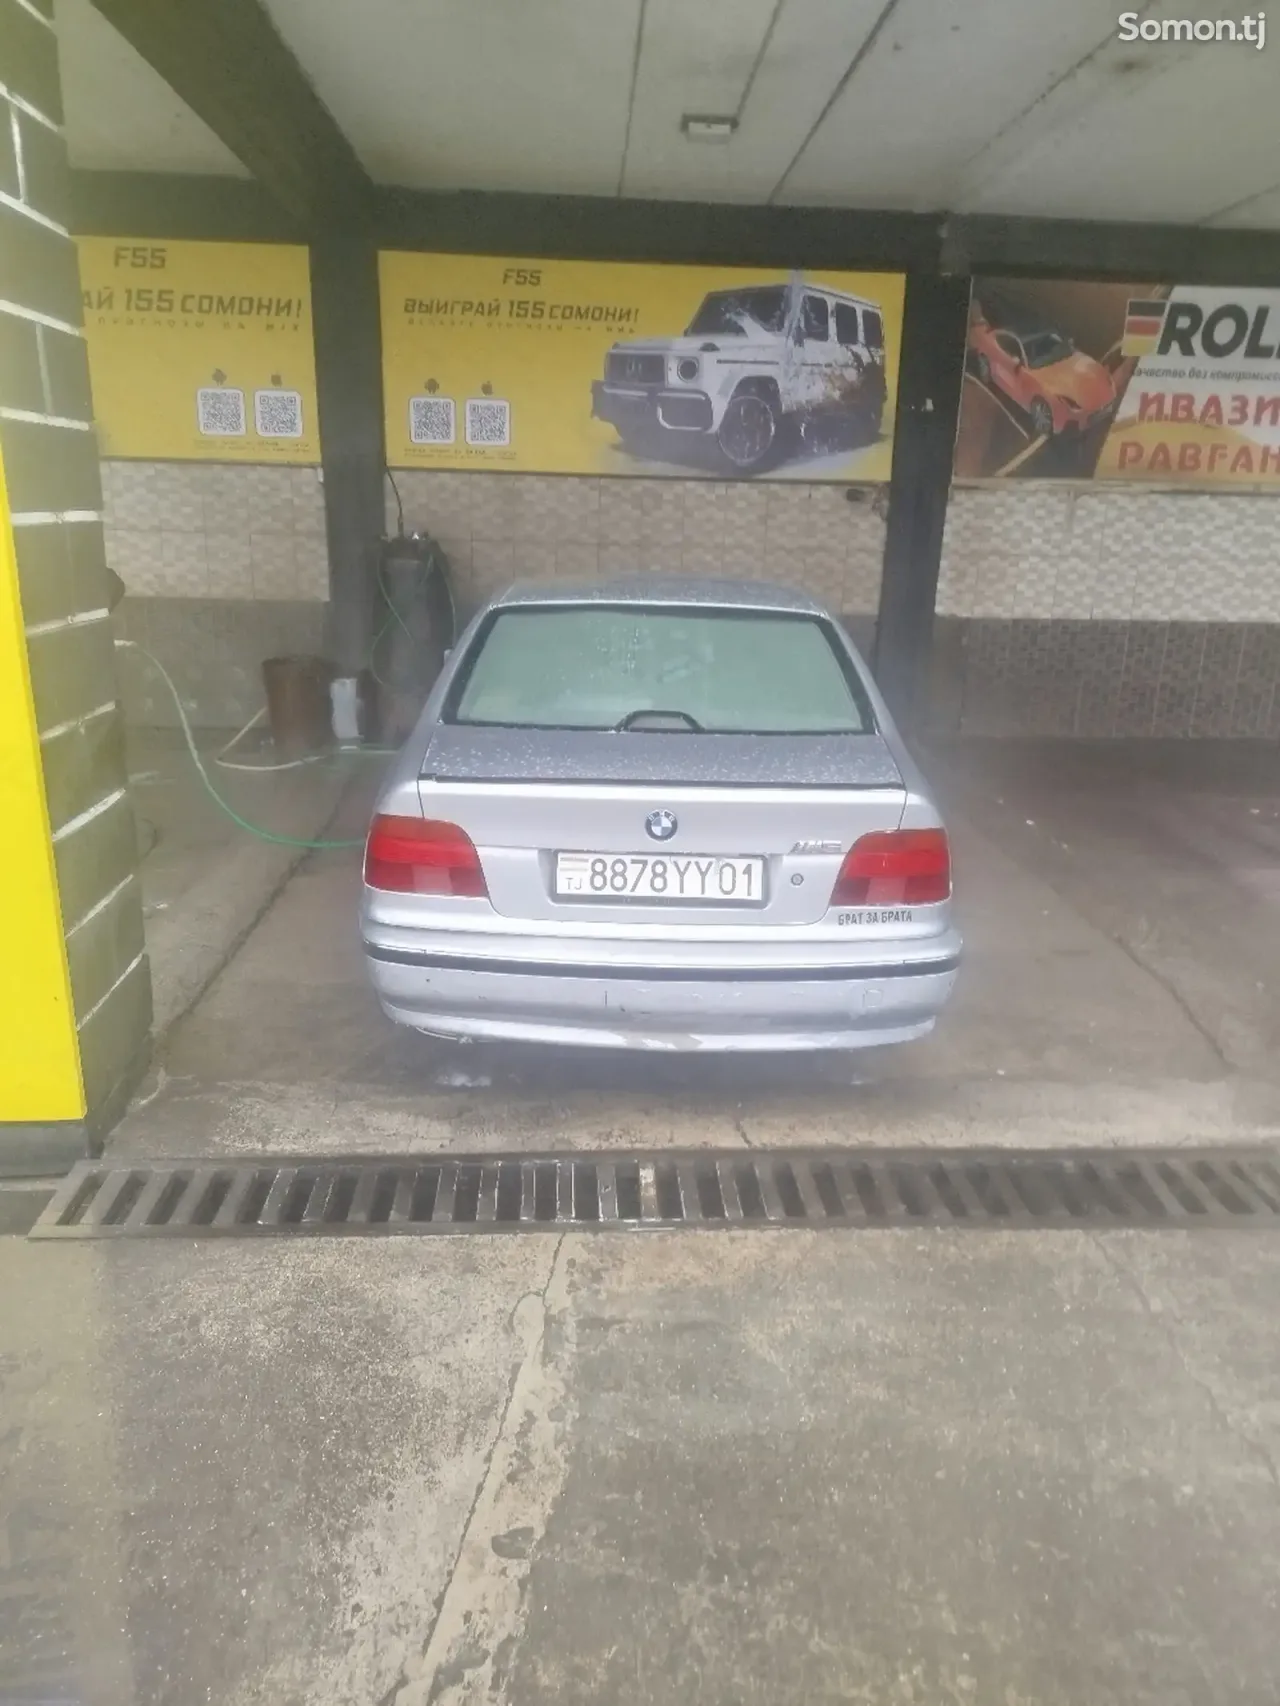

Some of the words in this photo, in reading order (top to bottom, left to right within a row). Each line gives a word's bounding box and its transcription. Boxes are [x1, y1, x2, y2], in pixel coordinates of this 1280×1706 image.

[114, 246, 167, 270] F55
[502, 268, 543, 287] F55
[125, 288, 174, 313] 155
[180, 293, 302, 320] СОМОНИ!
[403, 297, 501, 318] ВЫИГРАЙ
[507, 299, 546, 320] 155
[548, 303, 640, 325] СОМОНИ!
[1157, 301, 1280, 359] ROL
[565, 877, 583, 891] TJ
[589, 857, 753, 898] 8878YY01
[838, 912, 864, 926] БРАТ
[866, 911, 879, 924] ЗА
[881, 910, 913, 924] БРАТА
